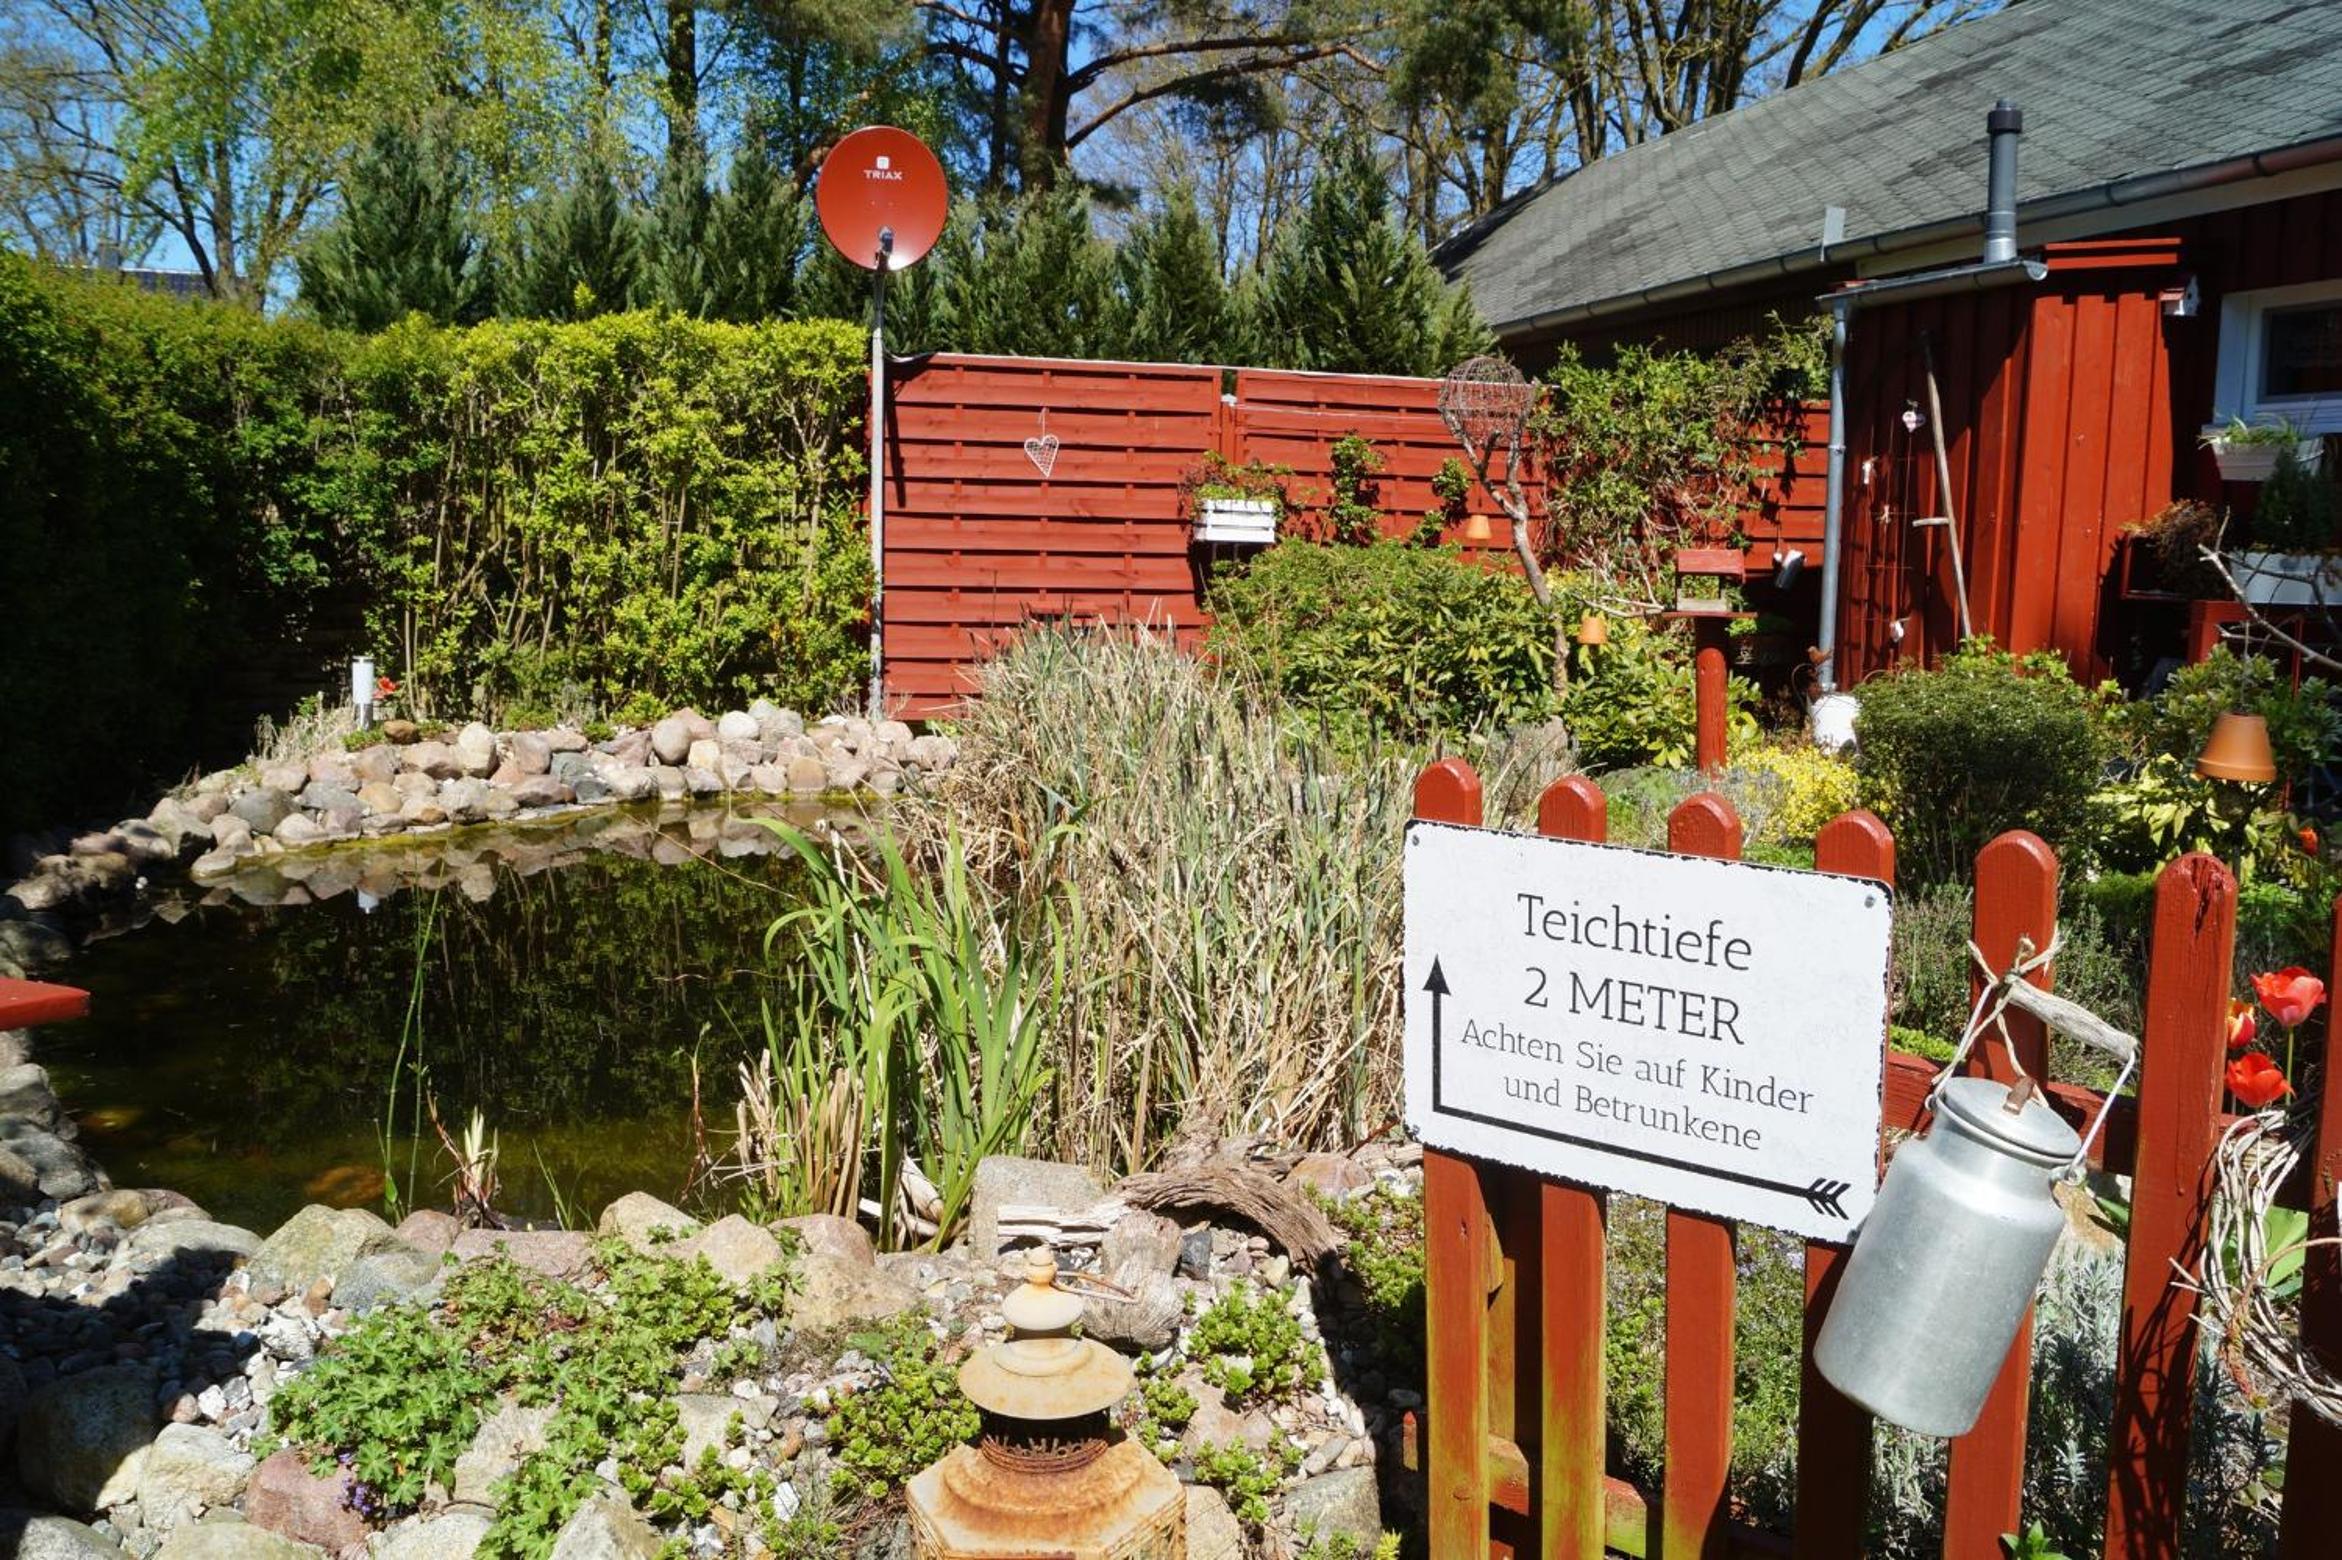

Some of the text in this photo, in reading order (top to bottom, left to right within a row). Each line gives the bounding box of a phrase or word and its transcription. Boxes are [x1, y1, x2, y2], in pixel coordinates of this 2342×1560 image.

[864, 169, 903, 180] TRIAX
[1517, 892, 1752, 971] Teichtiefe
[1523, 966, 1745, 1045] 2 METER
[1461, 1018, 1815, 1114] Achten Sie auf Kinder
[1503, 1073, 1762, 1151] und Betrunkene
